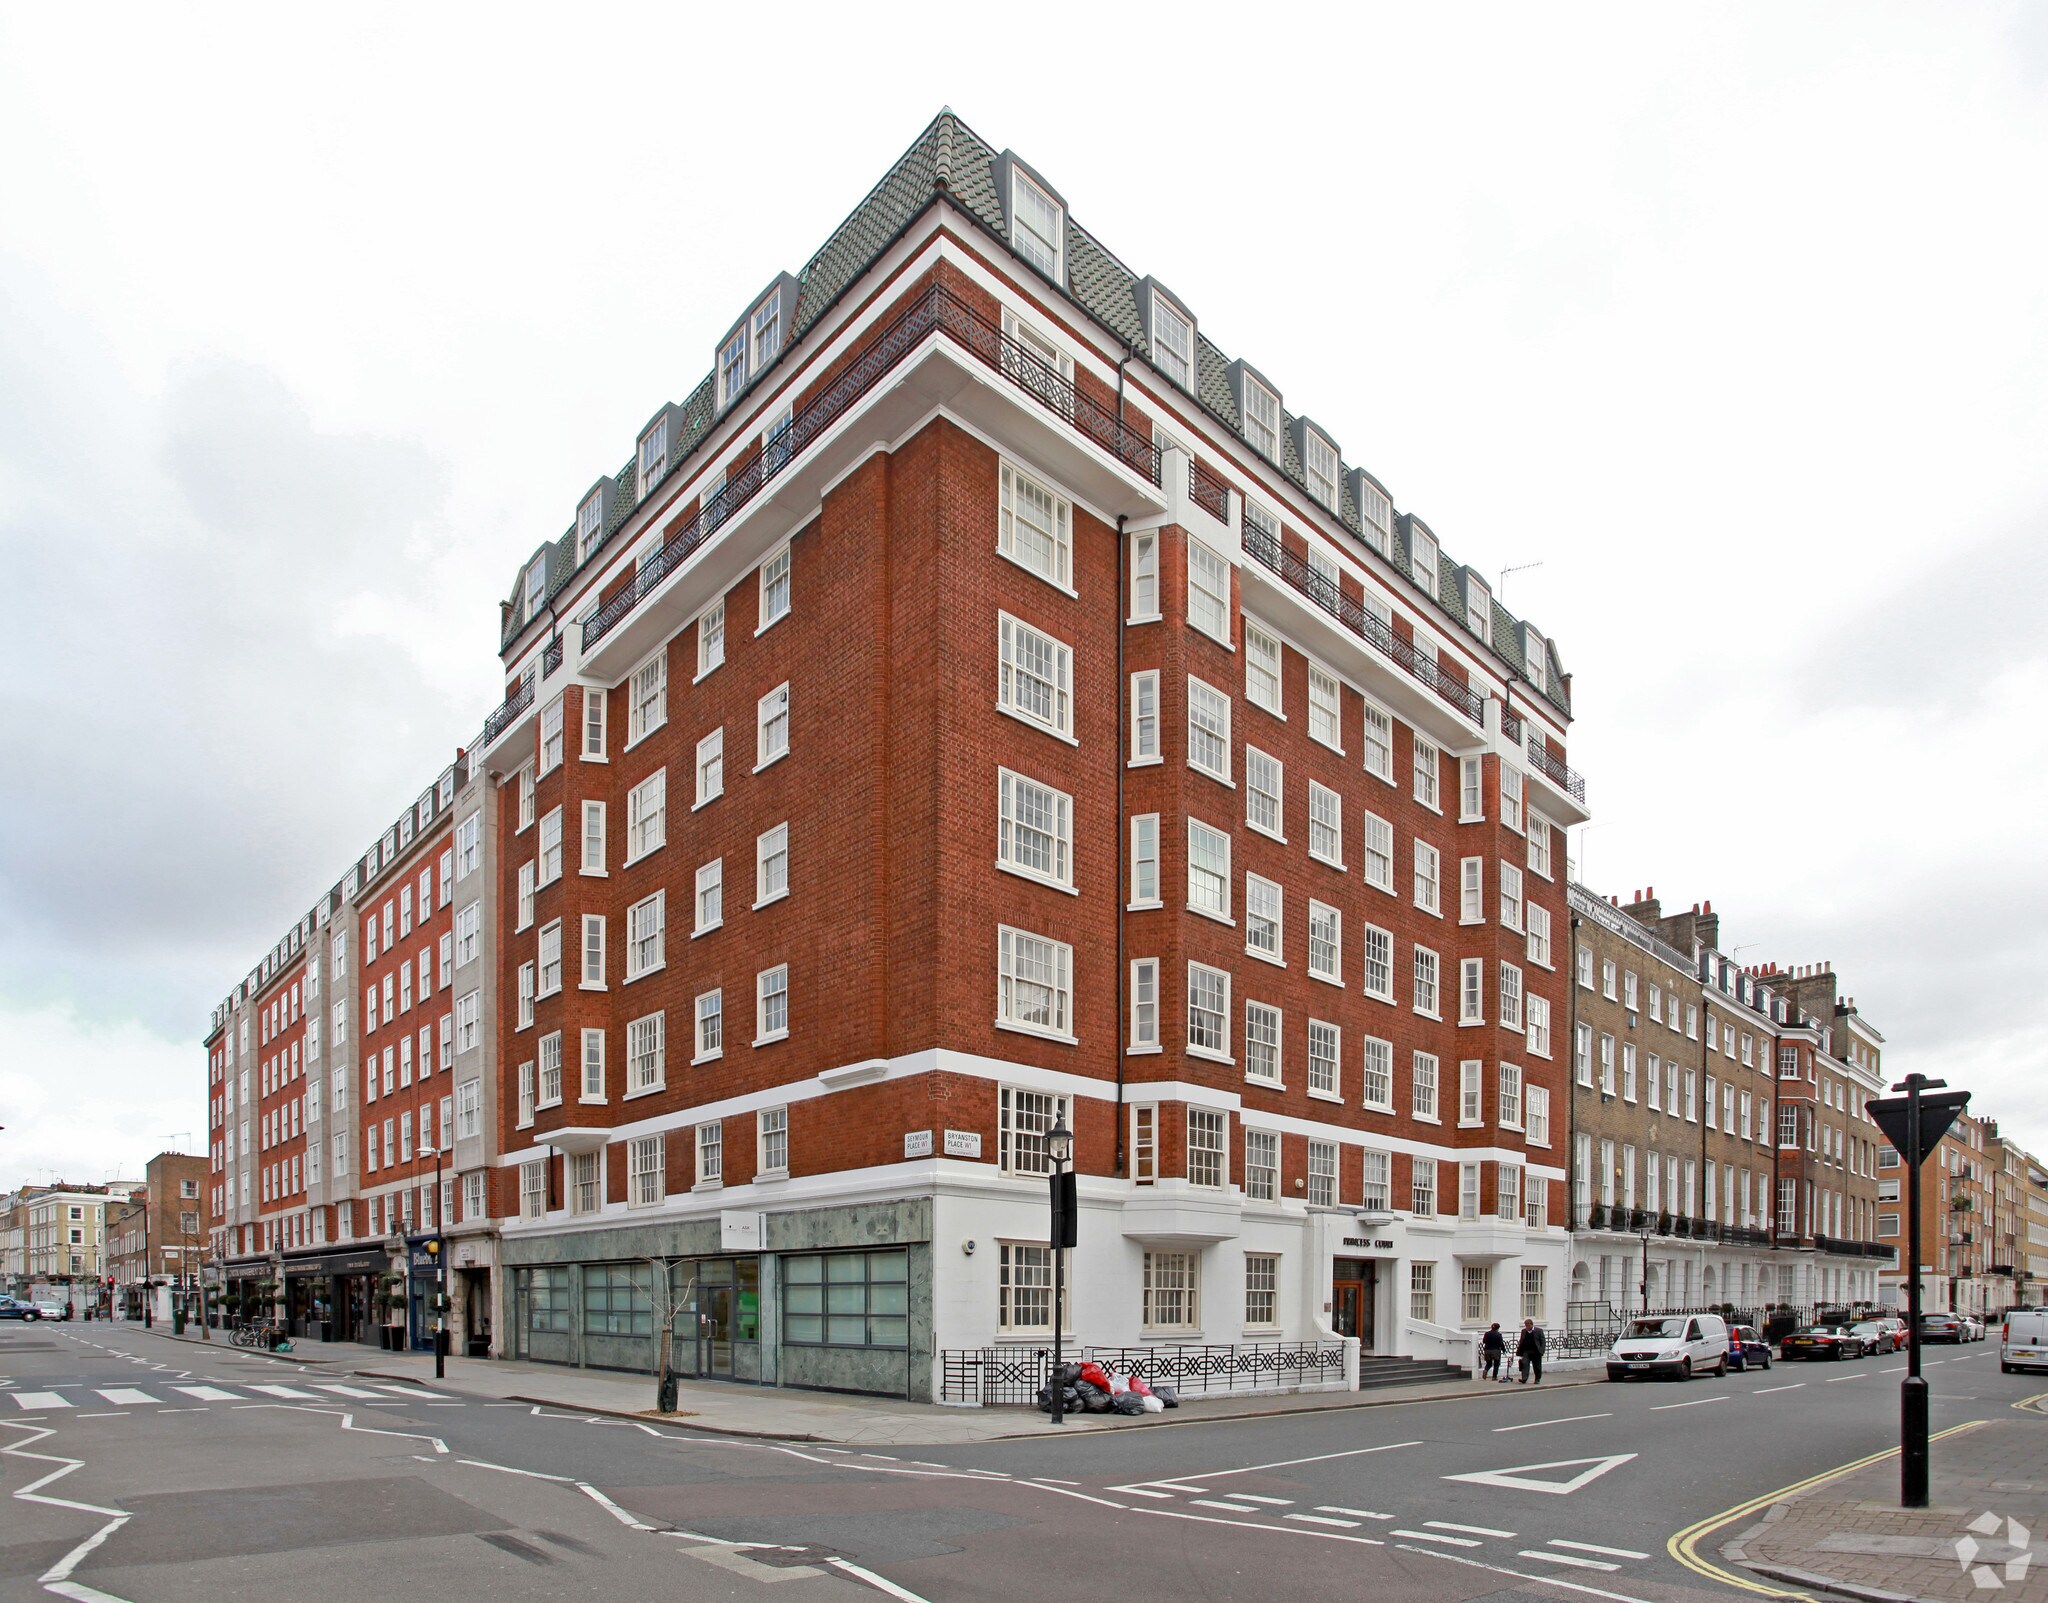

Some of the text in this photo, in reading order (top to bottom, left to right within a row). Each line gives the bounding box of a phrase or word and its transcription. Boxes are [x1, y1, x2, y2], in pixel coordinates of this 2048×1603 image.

[907, 1133, 928, 1142] SEYMOUR
[948, 1133, 978, 1142] BRYANSTON
[907, 1140, 928, 1150] PLACE W1
[948, 1140, 963, 1149] PLACE
[1343, 1237, 1394, 1249] PRINCESS COURT
